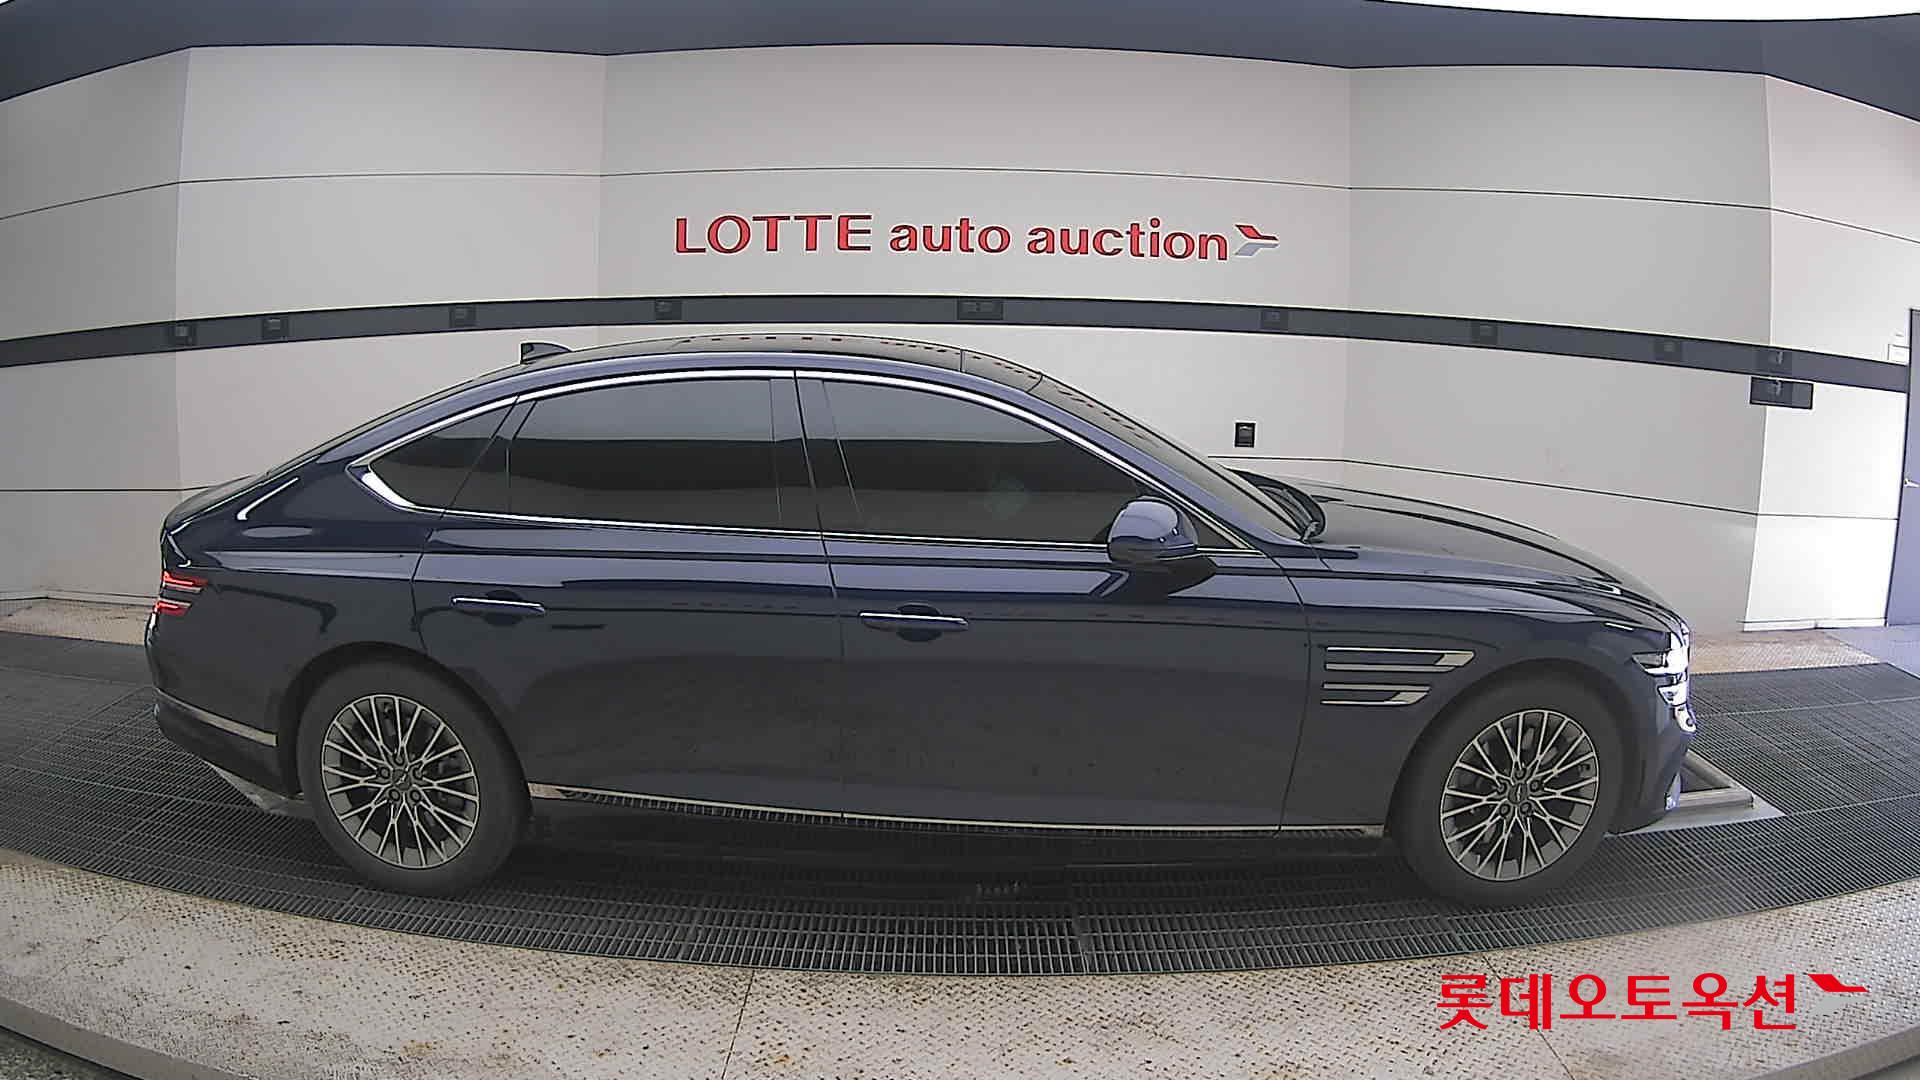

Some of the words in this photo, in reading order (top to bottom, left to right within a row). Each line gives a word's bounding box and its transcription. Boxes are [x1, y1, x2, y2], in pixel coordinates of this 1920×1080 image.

[675, 214, 872, 254] LOTTE
[889, 217, 1012, 254] auto
[1027, 217, 1229, 261] auction
